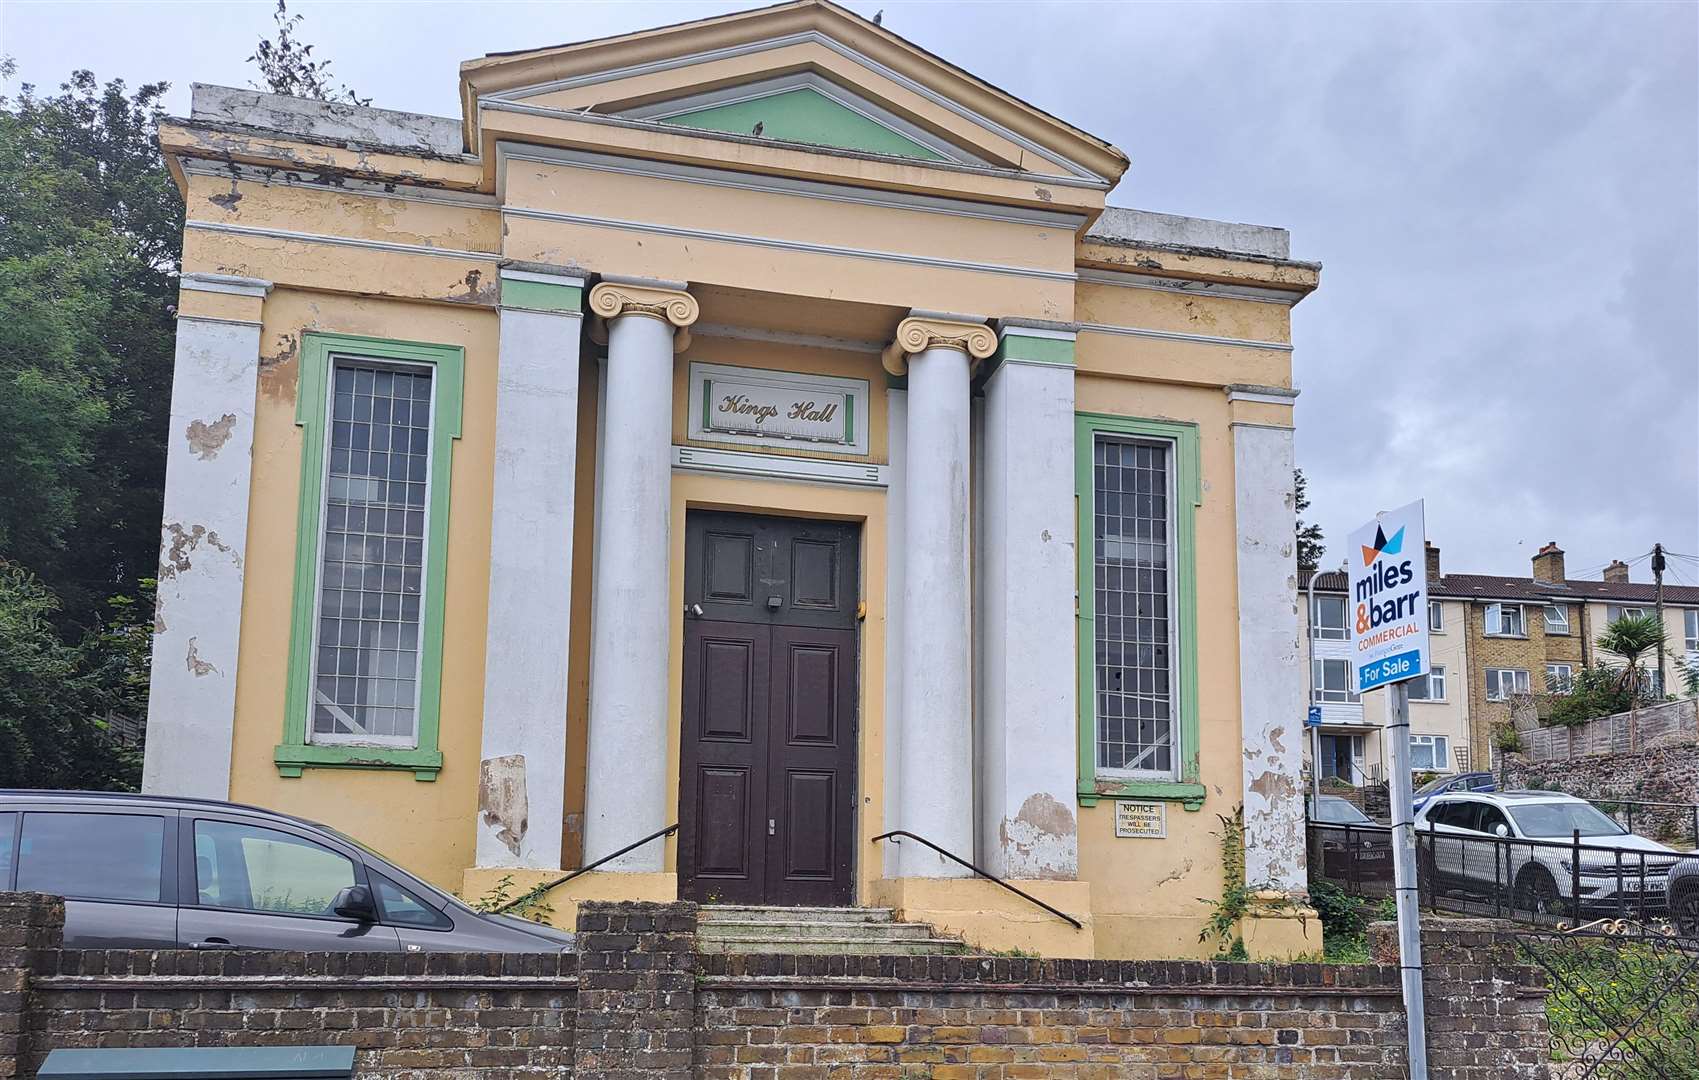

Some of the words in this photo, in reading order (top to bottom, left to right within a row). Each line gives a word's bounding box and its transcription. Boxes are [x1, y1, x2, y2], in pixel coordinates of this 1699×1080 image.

[718, 394, 778, 424] Kings
[787, 401, 838, 423] Hall
[1356, 560, 1413, 603] miles
[1358, 622, 1419, 651] COMMERCIAL
[1364, 667, 1380, 682] For
[1383, 658, 1410, 677] Sale
[1123, 804, 1155, 813] NOTICE
[1119, 827, 1160, 835] PROSECUTED
